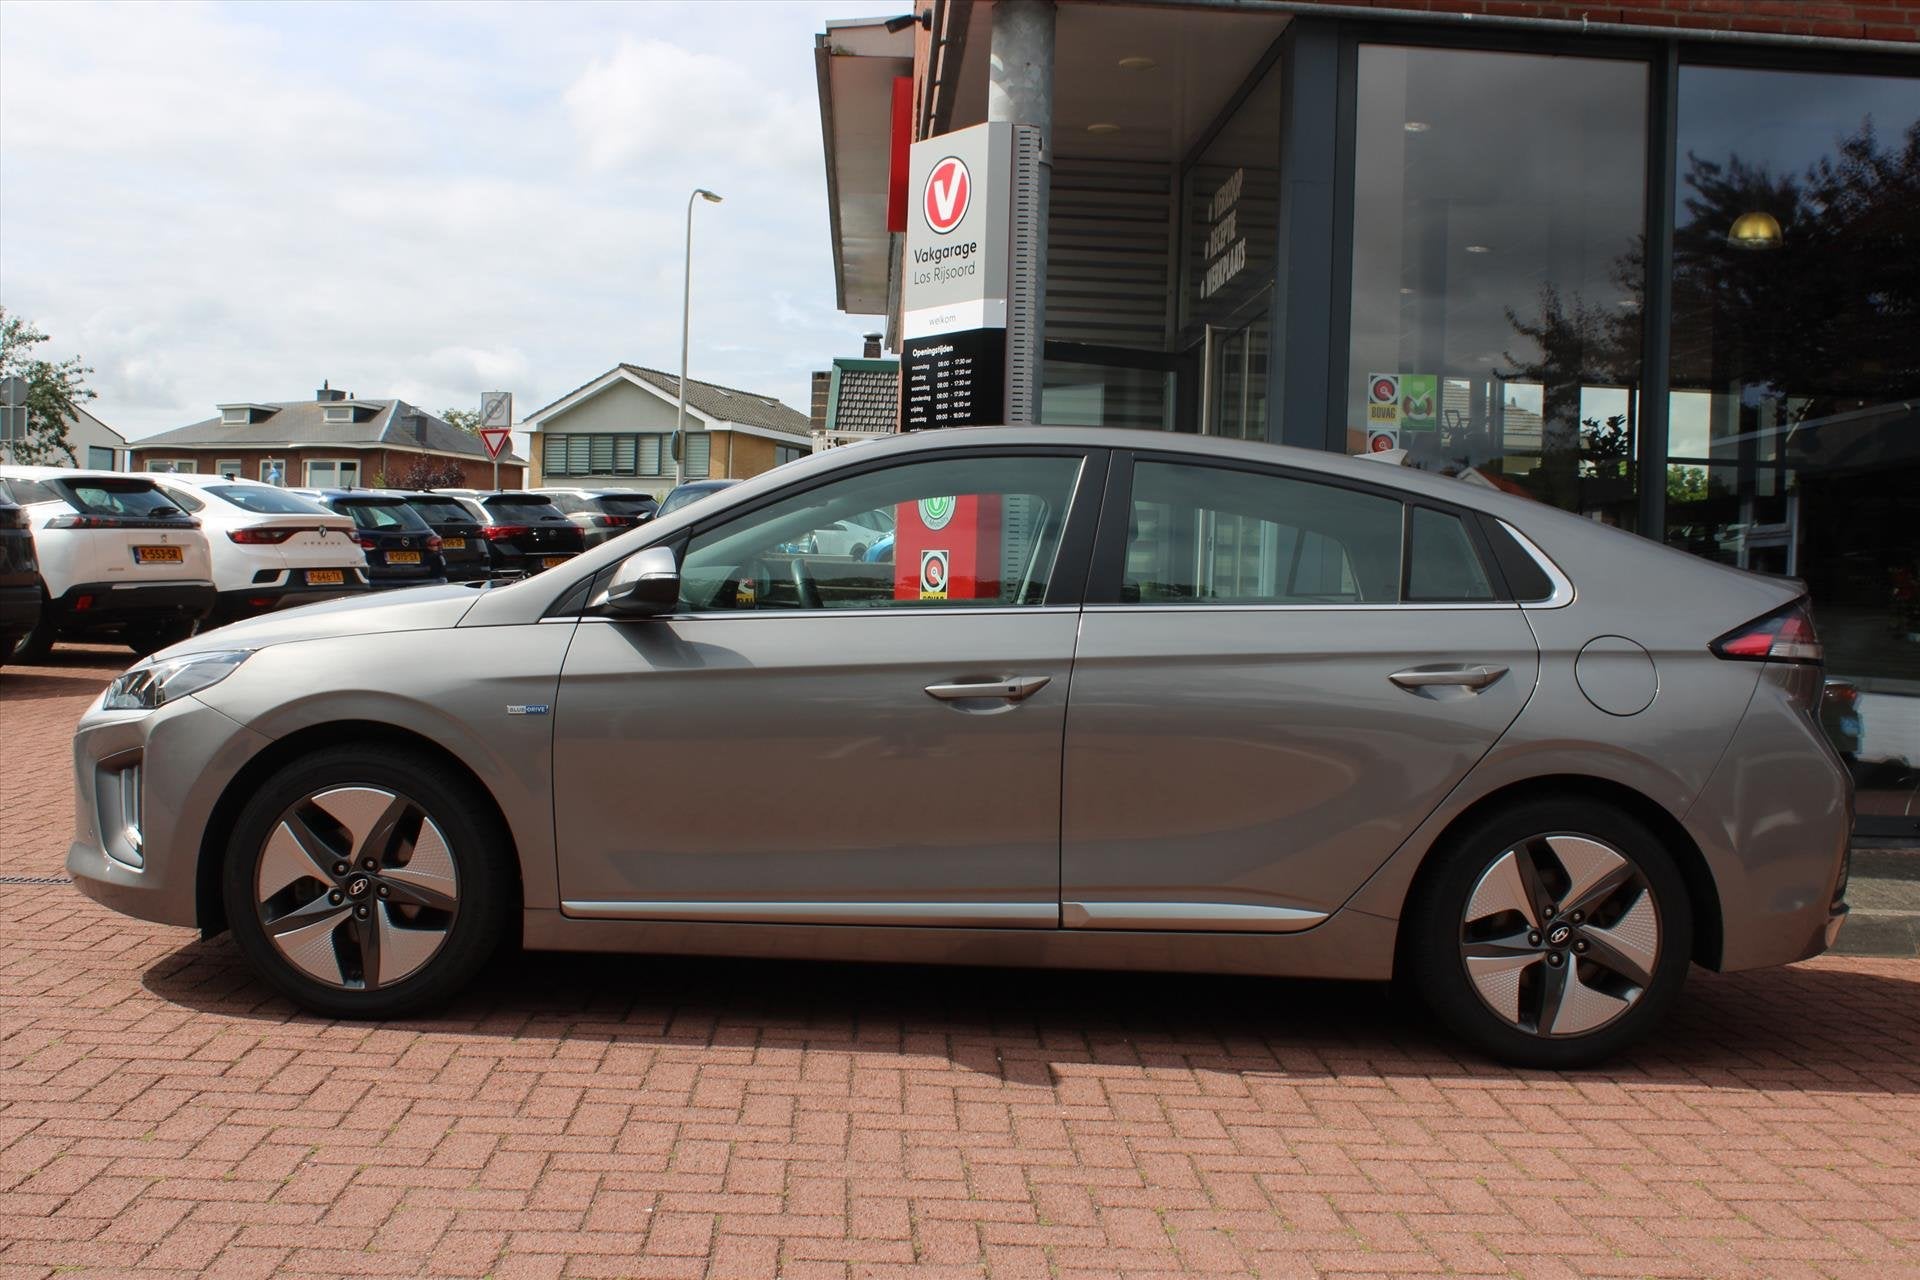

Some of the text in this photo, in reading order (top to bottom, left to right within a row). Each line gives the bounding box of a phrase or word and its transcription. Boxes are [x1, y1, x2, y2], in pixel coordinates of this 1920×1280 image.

[914, 242, 977, 264] Vakgarage
[914, 261, 976, 285] Los Rijsoord
[1206, 237, 1245, 297] WERKPLAATS
[929, 314, 956, 326] welkom
[912, 345, 954, 358] Openingstijden
[1371, 406, 1396, 419] BOVAG
[141, 548, 178, 560] K-553-SR
